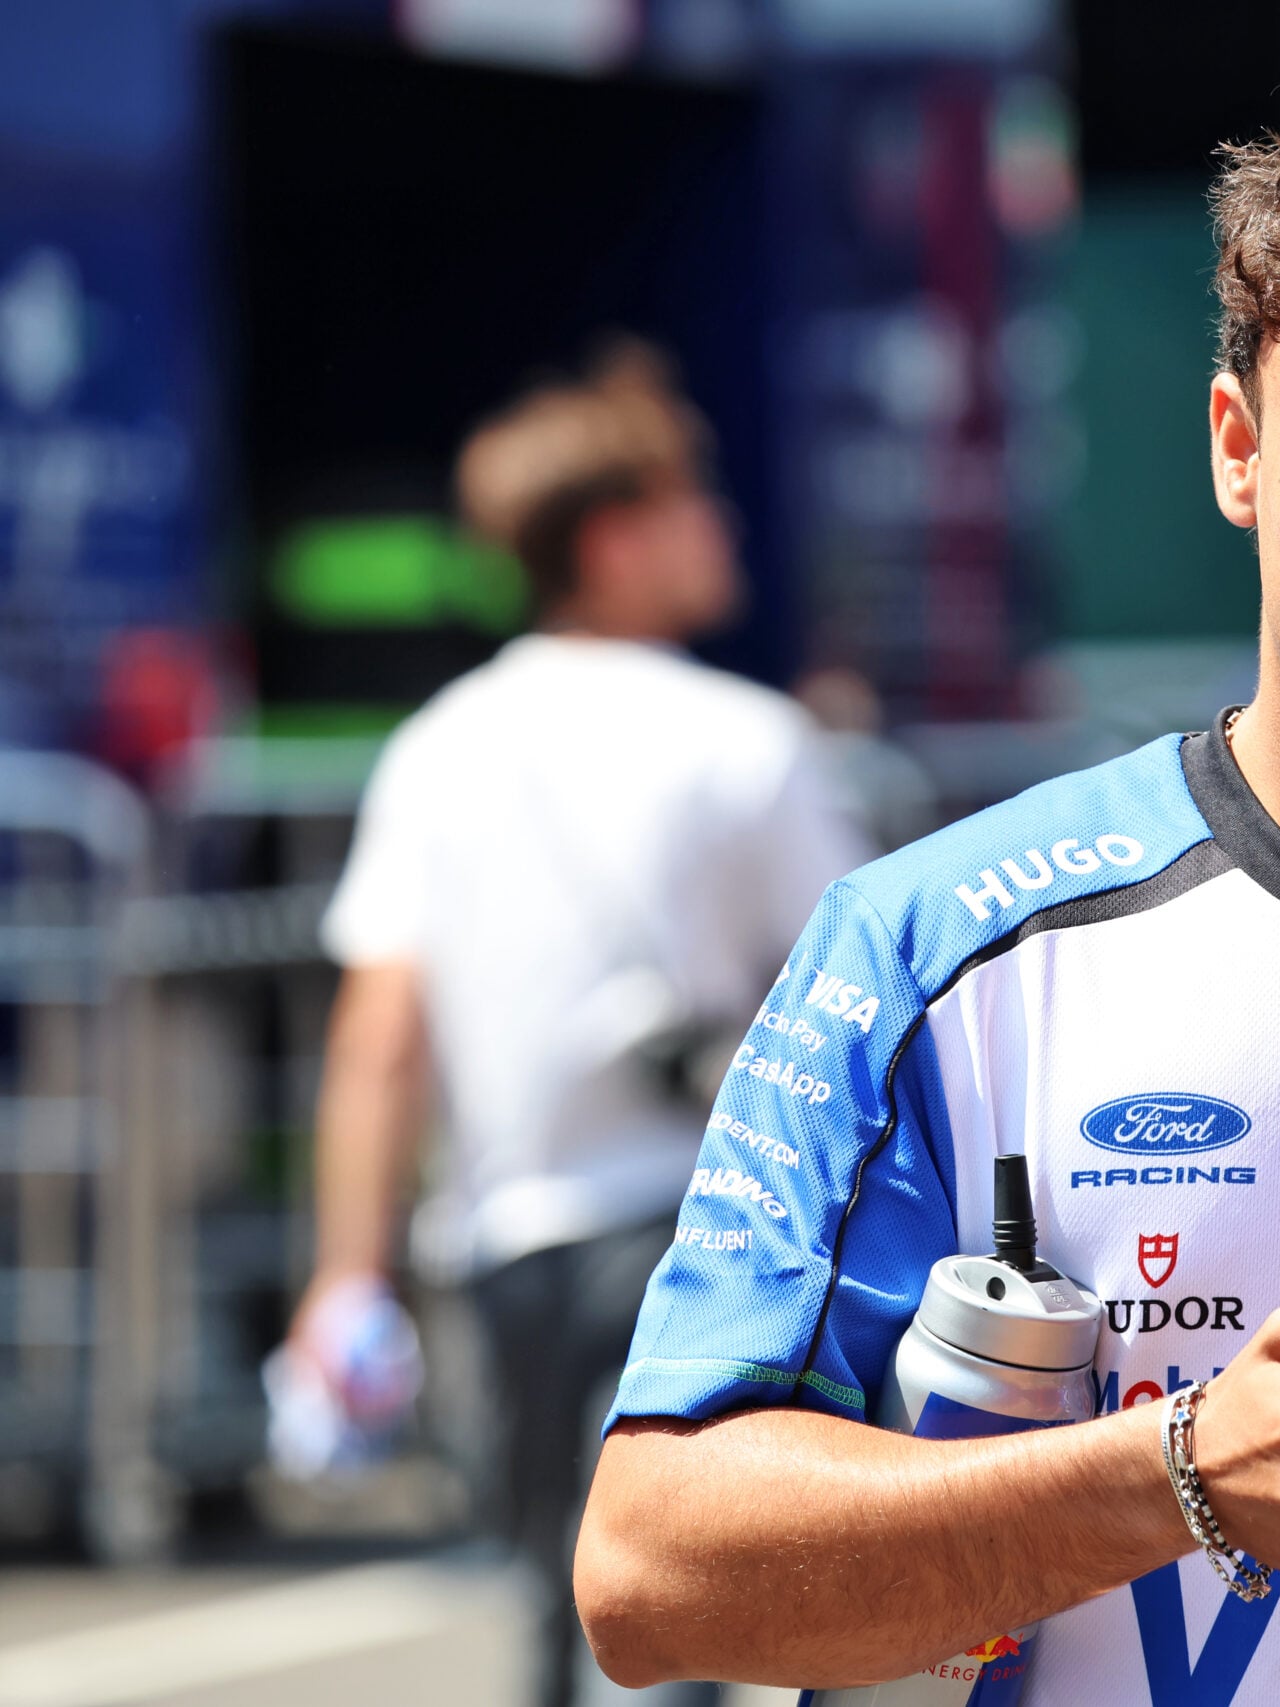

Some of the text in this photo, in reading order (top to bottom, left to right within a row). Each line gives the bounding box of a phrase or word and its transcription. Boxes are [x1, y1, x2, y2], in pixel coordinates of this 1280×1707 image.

[953, 833, 1145, 922] HUGO
[804, 966, 880, 1034] VISA
[1113, 1102, 1217, 1143] Ford
[1071, 1166, 1256, 1189] RACING
[674, 1226, 753, 1251] NFLUENT
[1101, 1296, 1245, 1334] UDOR
[921, 1664, 988, 1682] NERGY
